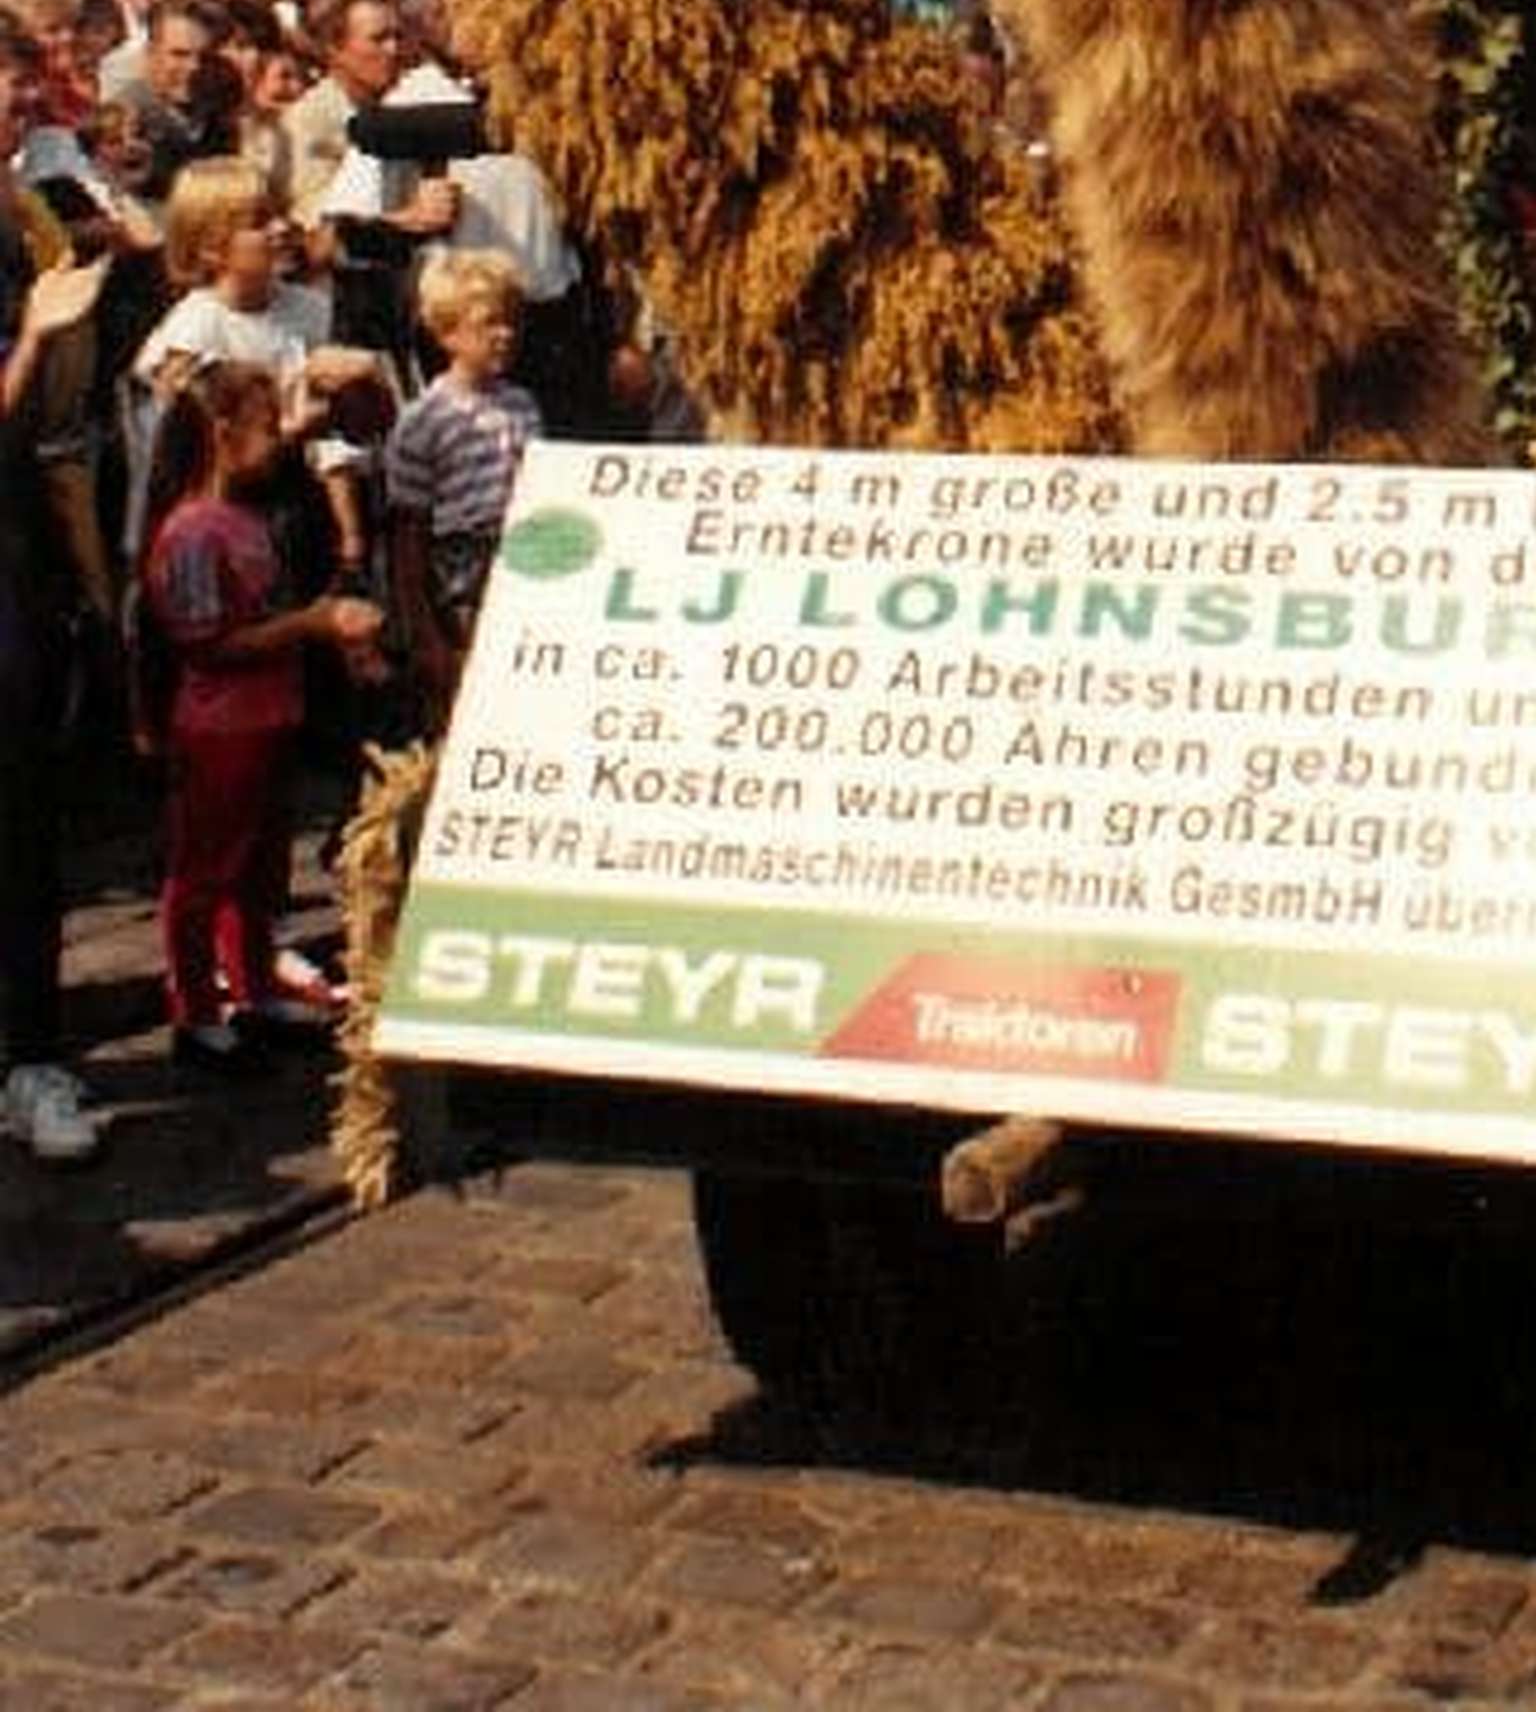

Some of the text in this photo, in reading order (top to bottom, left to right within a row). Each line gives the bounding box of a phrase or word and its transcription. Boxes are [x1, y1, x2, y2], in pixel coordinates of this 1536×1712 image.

[589, 456, 762, 505] Diese
[790, 463, 818, 498] 4
[850, 469, 903, 508] m
[930, 469, 1125, 521] große
[1152, 477, 1280, 524] und
[1306, 479, 1412, 526] 2.5
[1441, 491, 1498, 529] m
[685, 509, 1054, 567] Erntekrone
[1086, 531, 1298, 578] wurde
[1333, 540, 1455, 584] von
[602, 567, 746, 623] LJ
[513, 631, 565, 672] in
[594, 648, 683, 683] ca.
[721, 643, 861, 690] 1000
[888, 649, 1433, 722] Arbeitsstunden
[591, 707, 682, 743] ca.
[713, 701, 976, 759] 200.000
[469, 747, 565, 793] Die
[590, 756, 802, 811] Kosten
[835, 777, 1075, 831] wurden
[1104, 793, 1457, 863] großzügig
[434, 809, 583, 866] STEYR
[594, 824, 1149, 910] Landmaschinentechnik
[1169, 867, 1383, 927] GesmbH
[415, 929, 826, 1033] STEYR
